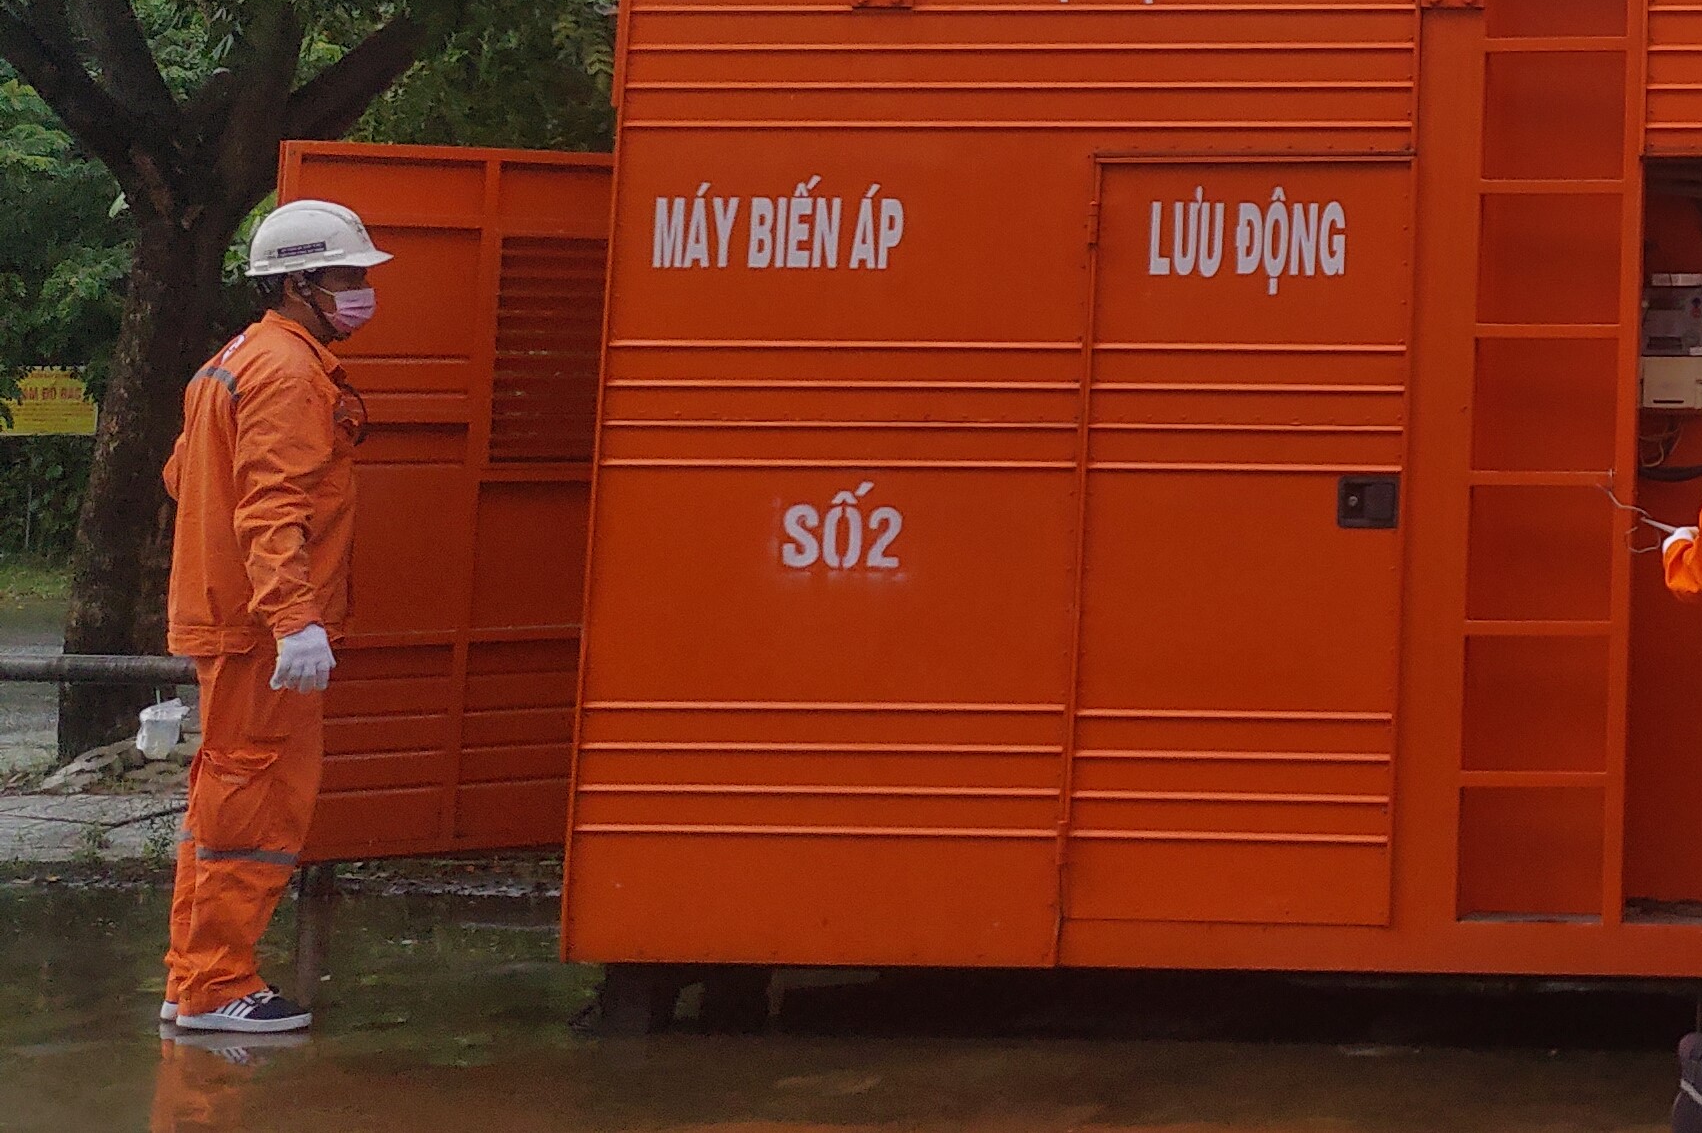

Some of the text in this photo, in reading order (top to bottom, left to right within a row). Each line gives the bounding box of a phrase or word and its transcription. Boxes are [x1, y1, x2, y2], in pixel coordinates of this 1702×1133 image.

[652, 174, 904, 269] MÁY BIẾN ÁP
[1236, 186, 1346, 295] ĐỘNG
